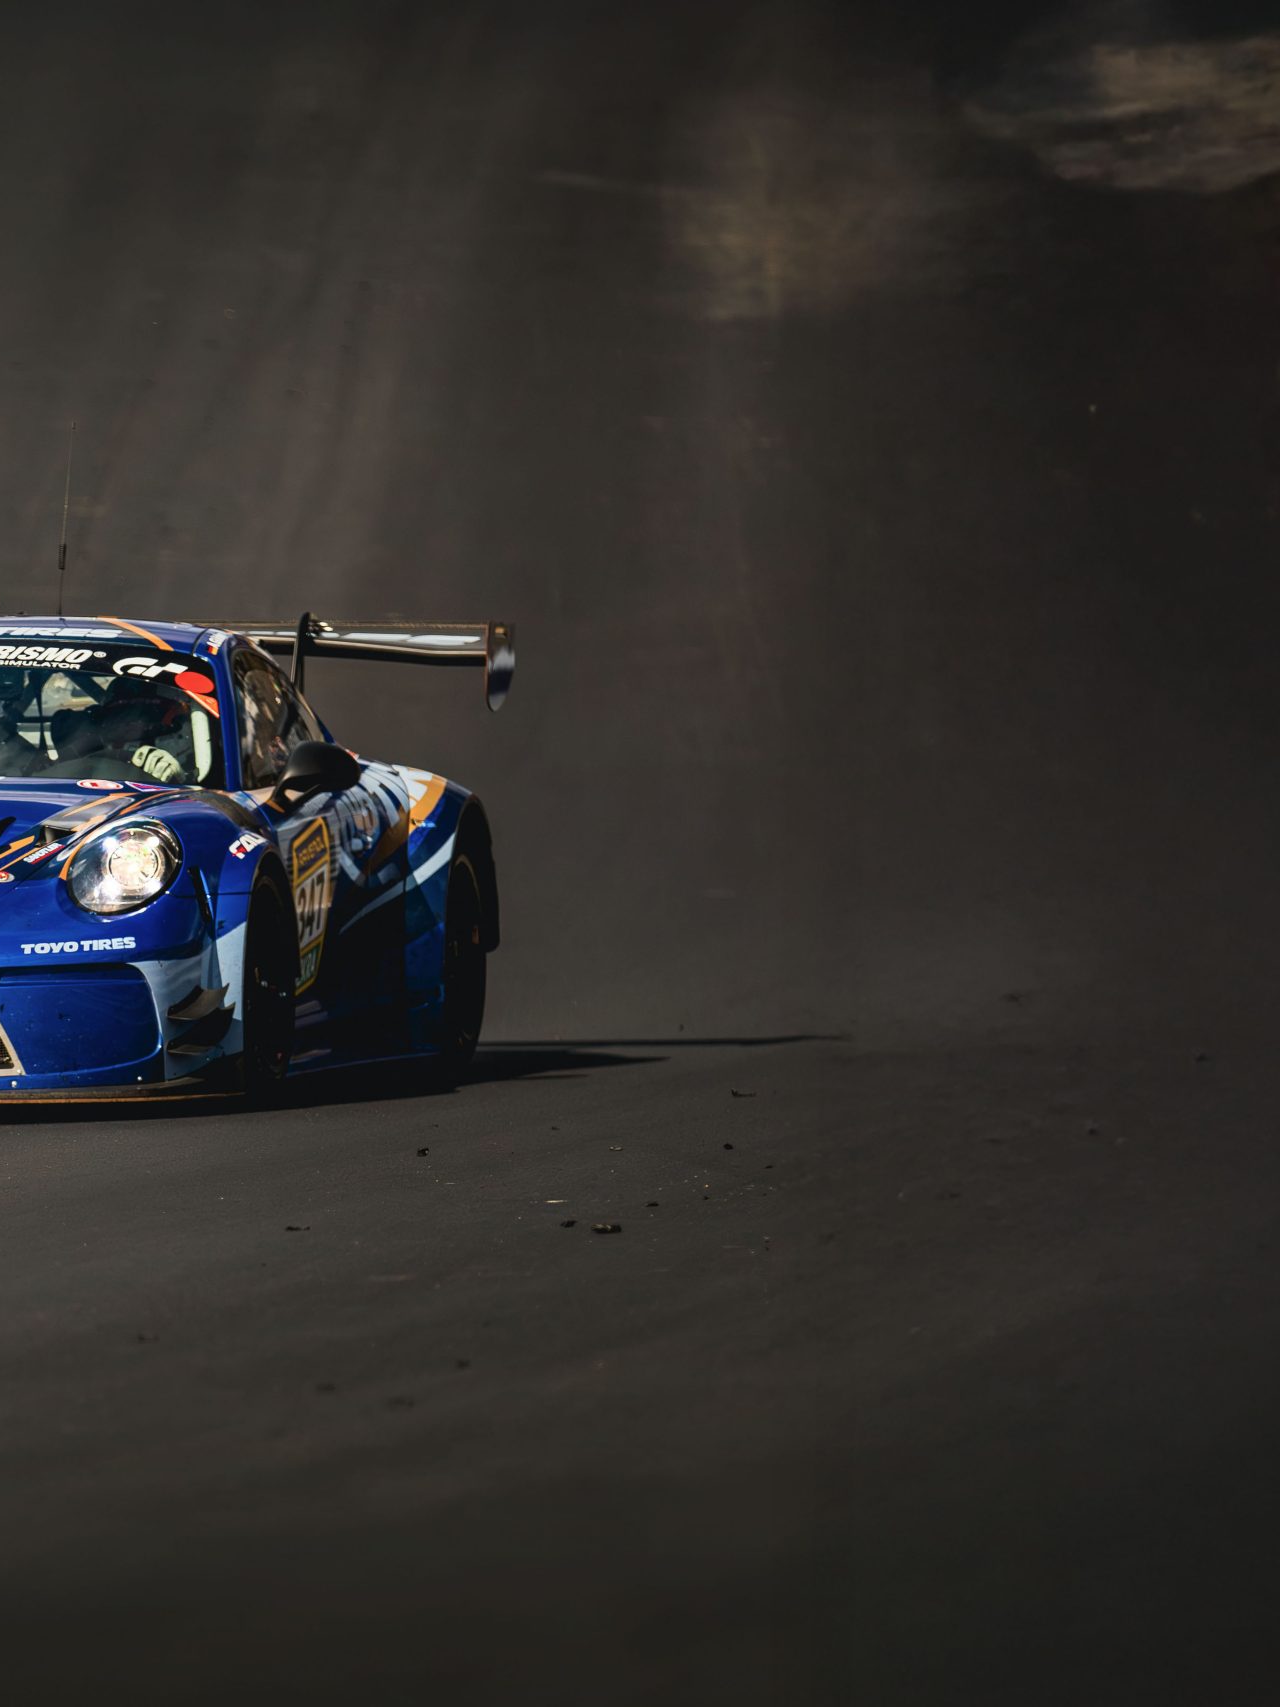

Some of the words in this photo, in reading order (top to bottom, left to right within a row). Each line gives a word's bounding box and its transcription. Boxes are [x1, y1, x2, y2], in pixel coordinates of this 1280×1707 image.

[298, 870, 325, 942] 347
[20, 941, 79, 954] TOYO
[80, 936, 137, 952] TIRES
